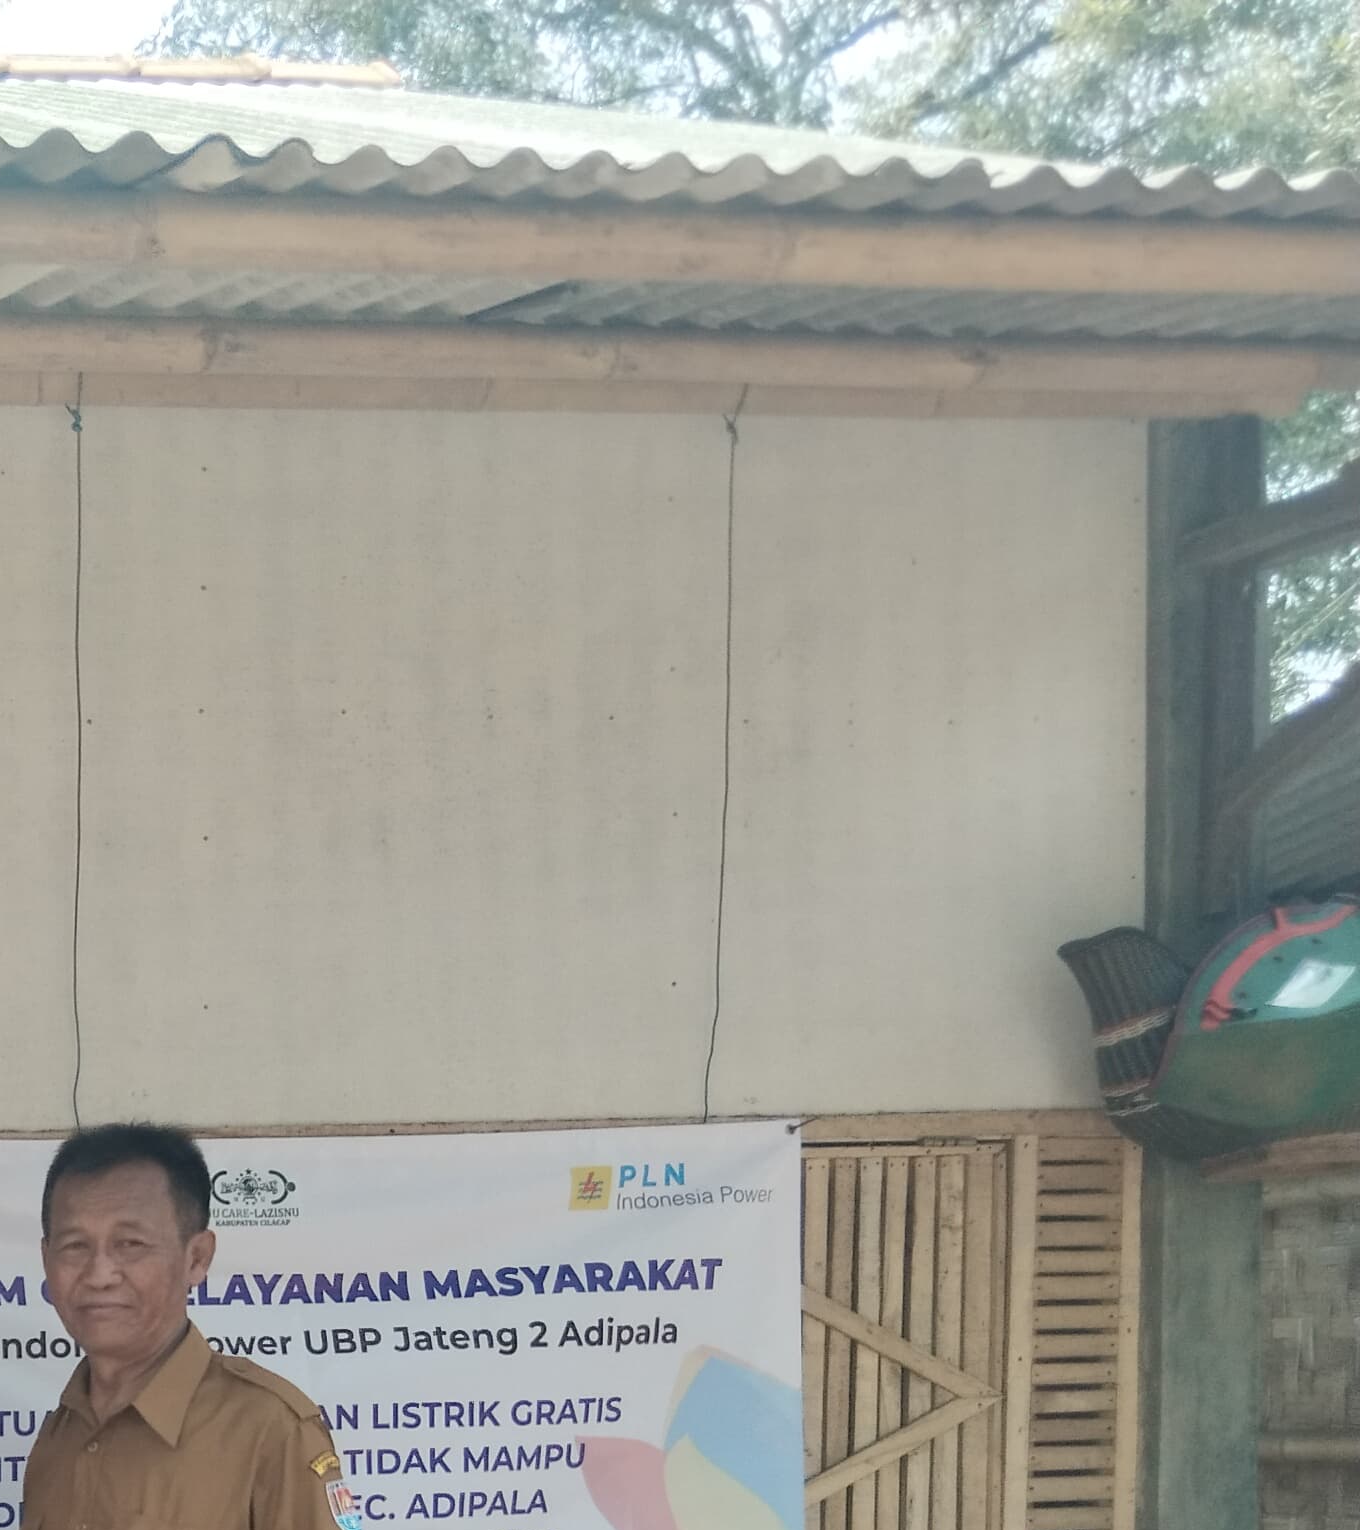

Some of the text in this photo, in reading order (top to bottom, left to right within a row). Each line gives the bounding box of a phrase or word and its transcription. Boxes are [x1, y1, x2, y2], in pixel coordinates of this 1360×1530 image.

[619, 1163, 684, 1188] PLN
[222, 1208, 299, 1218] CARE-LAZISNU
[617, 1186, 772, 1210] Indonesia Power
[187, 1271, 410, 1305] LAYANAN
[424, 1259, 722, 1300] MASYARAKAT
[206, 1336, 291, 1355] ower
[304, 1328, 381, 1354] UBP
[394, 1327, 517, 1355] Jateng
[529, 1321, 548, 1347] 2
[559, 1317, 677, 1352] Adipala
[373, 1401, 500, 1429] LISTRIK
[511, 1397, 621, 1426] GRATIS
[343, 1448, 451, 1475] TIDAK
[464, 1443, 585, 1472] MAMPU
[406, 1489, 547, 1519] ADIPALA
